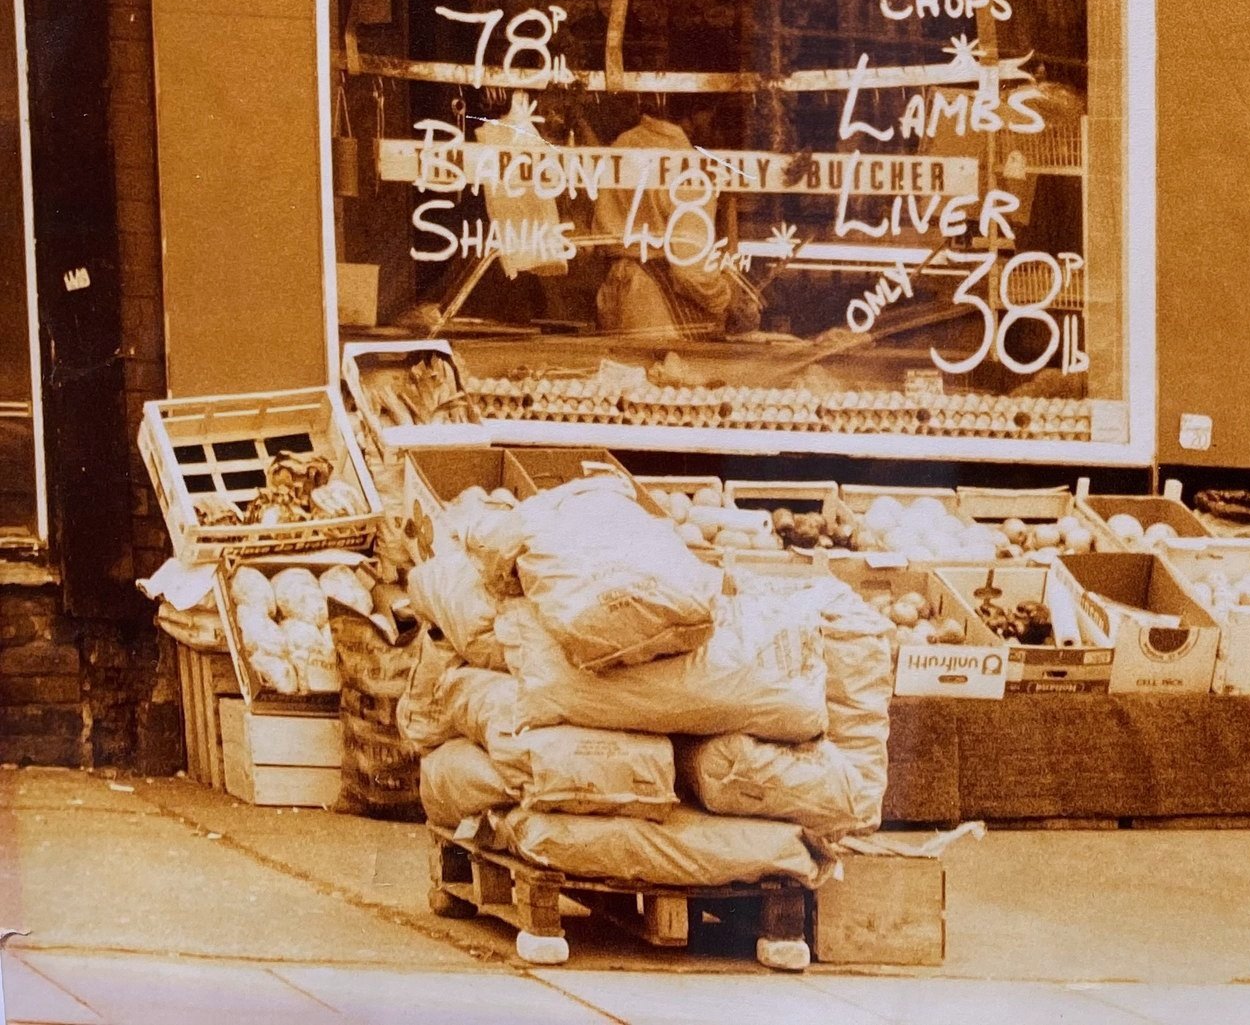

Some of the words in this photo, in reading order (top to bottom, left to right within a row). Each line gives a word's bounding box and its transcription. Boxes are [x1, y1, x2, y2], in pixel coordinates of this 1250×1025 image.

[838, 53, 1046, 141] LAMBS
[806, 159, 946, 192] BUTCHER
[835, 149, 1021, 240] LIVER
